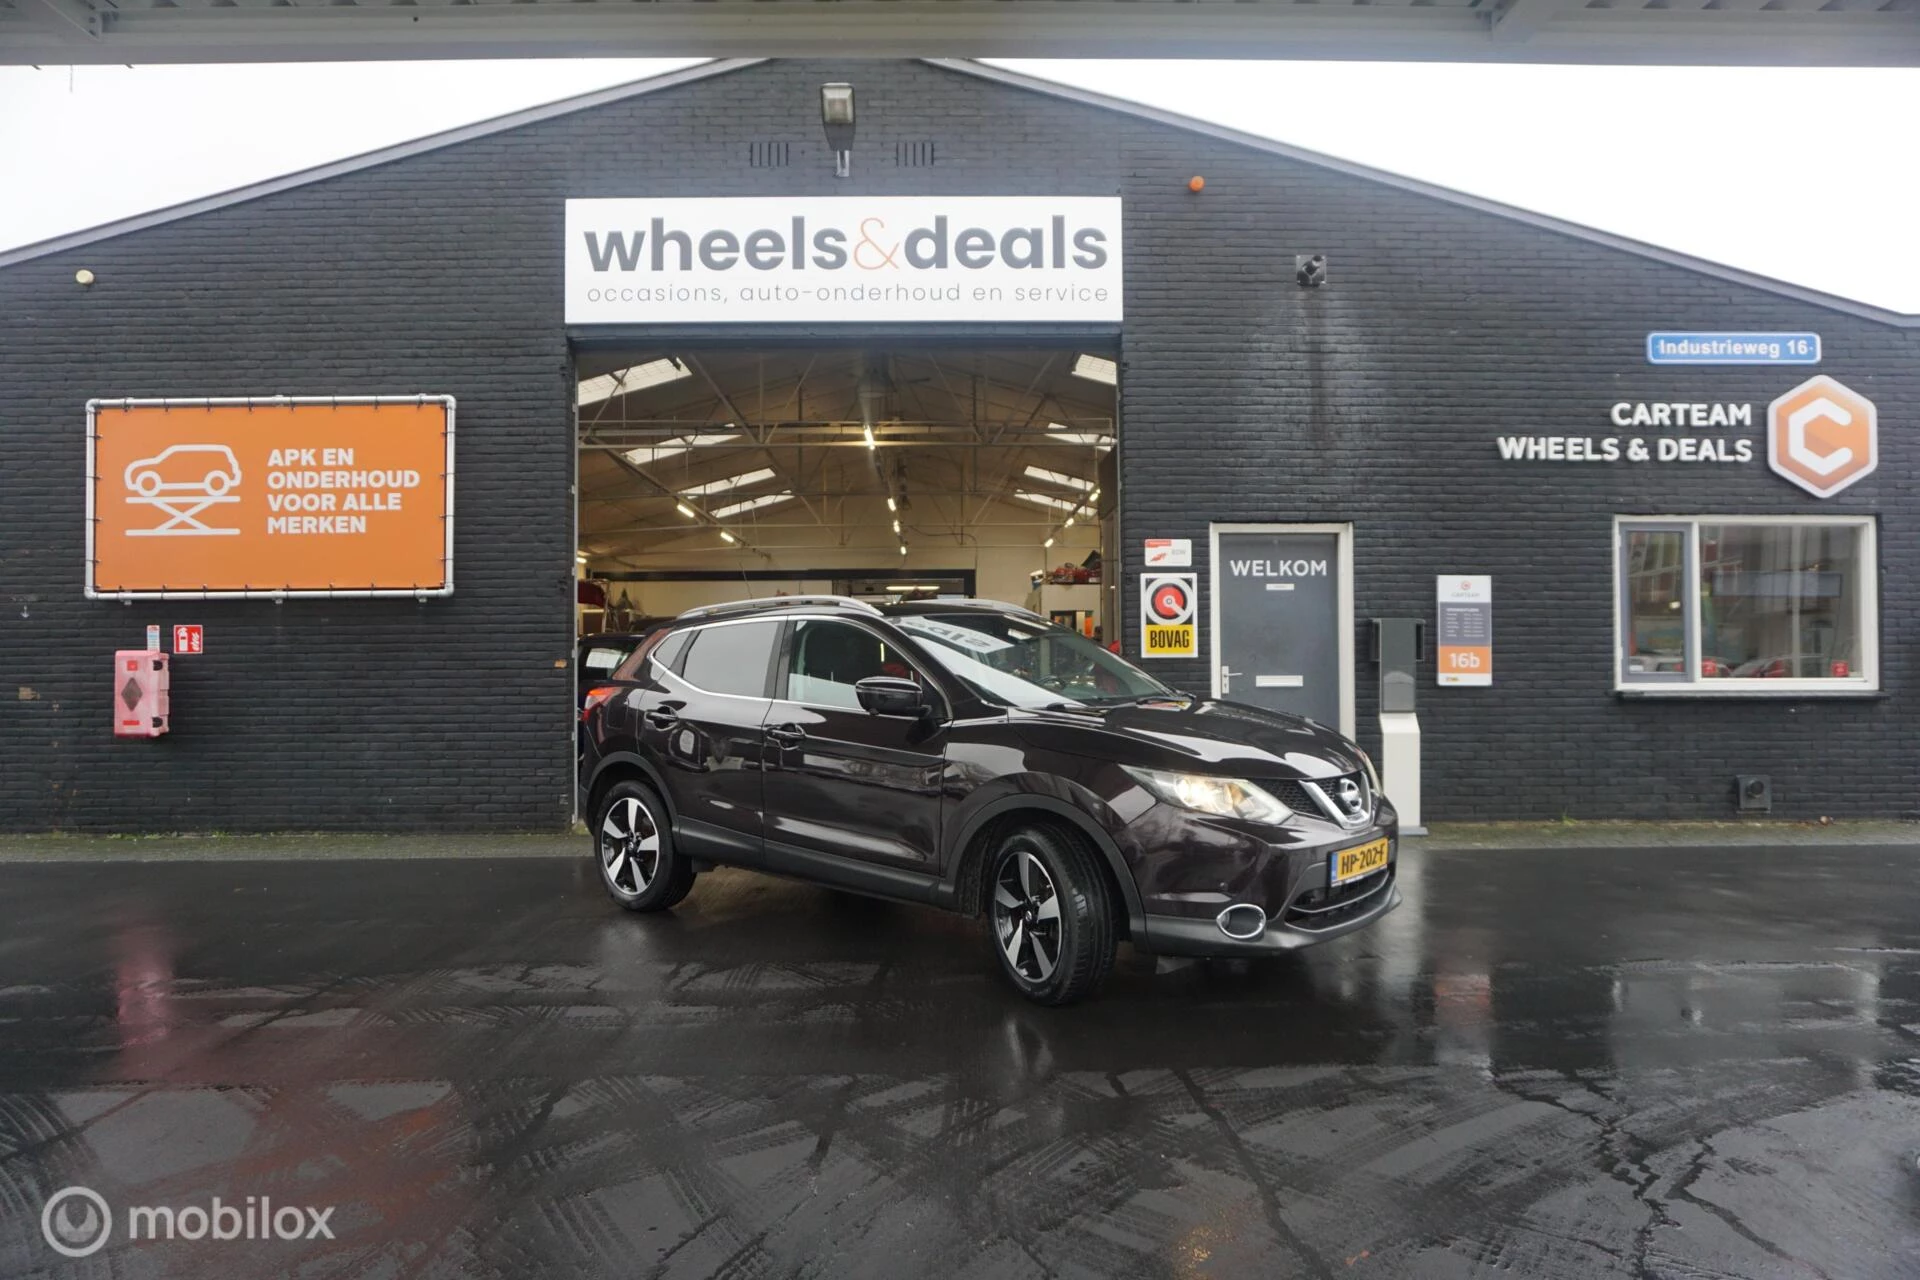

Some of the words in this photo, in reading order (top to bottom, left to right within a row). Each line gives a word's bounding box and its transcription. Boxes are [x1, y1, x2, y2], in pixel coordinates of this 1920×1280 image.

[587, 284, 728, 305] occasions,
[739, 283, 962, 303] auto-onderhoud
[972, 287, 1003, 301] en
[1015, 284, 1108, 302] service
[1659, 339, 1781, 358] Industrieweg
[1787, 339, 1809, 355] 16
[1610, 403, 1752, 426] CARTEAM
[267, 449, 316, 467] APK
[322, 448, 354, 466] EN
[1497, 437, 1620, 461] WHEELS
[1627, 439, 1650, 461] &
[1657, 439, 1753, 462] DEALS
[267, 470, 420, 489] ONDERHOUD
[267, 494, 337, 512] VOOR
[342, 492, 402, 511] ALLE
[267, 516, 366, 535] MERKEN
[1229, 560, 1327, 577] WELKOM
[1150, 629, 1190, 649] BOVAG
[1449, 652, 1480, 669] 16b
